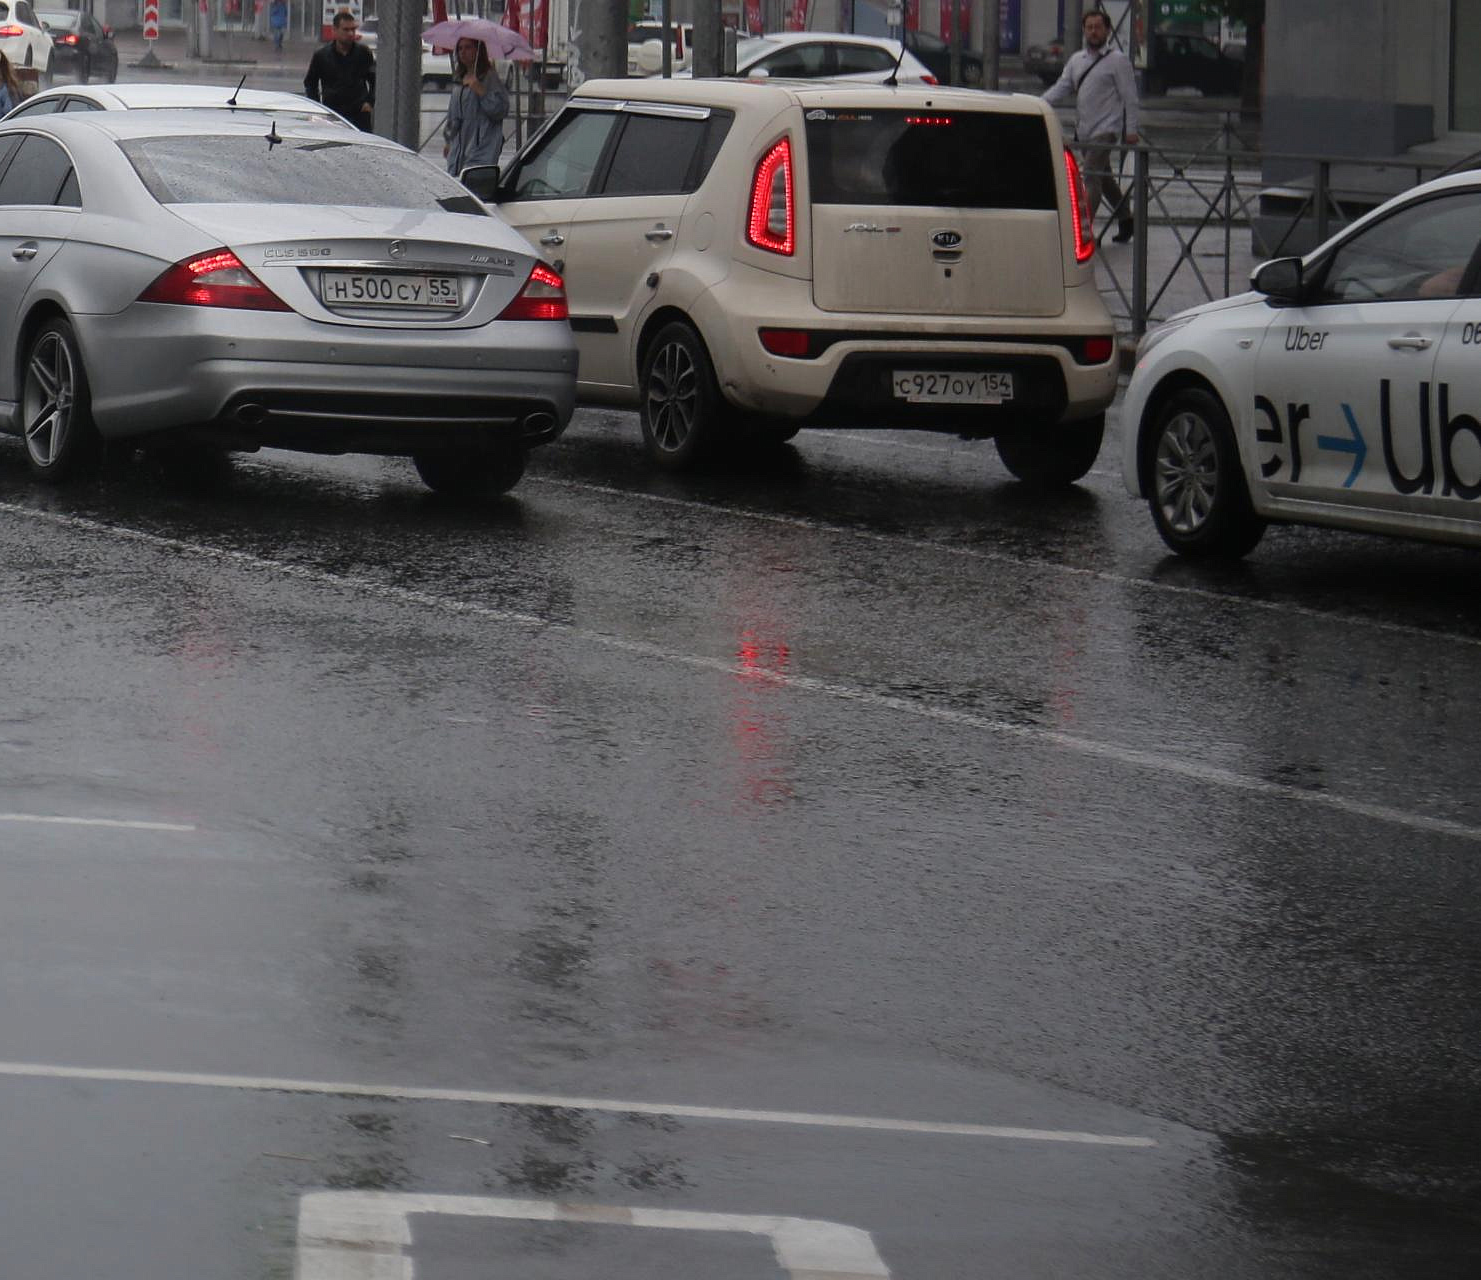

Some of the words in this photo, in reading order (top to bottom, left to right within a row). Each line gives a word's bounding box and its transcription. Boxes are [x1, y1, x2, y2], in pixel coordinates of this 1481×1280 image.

[430, 279, 451, 296] 55
[1285, 325, 1330, 352] Uber
[980, 374, 1011, 391] 154
